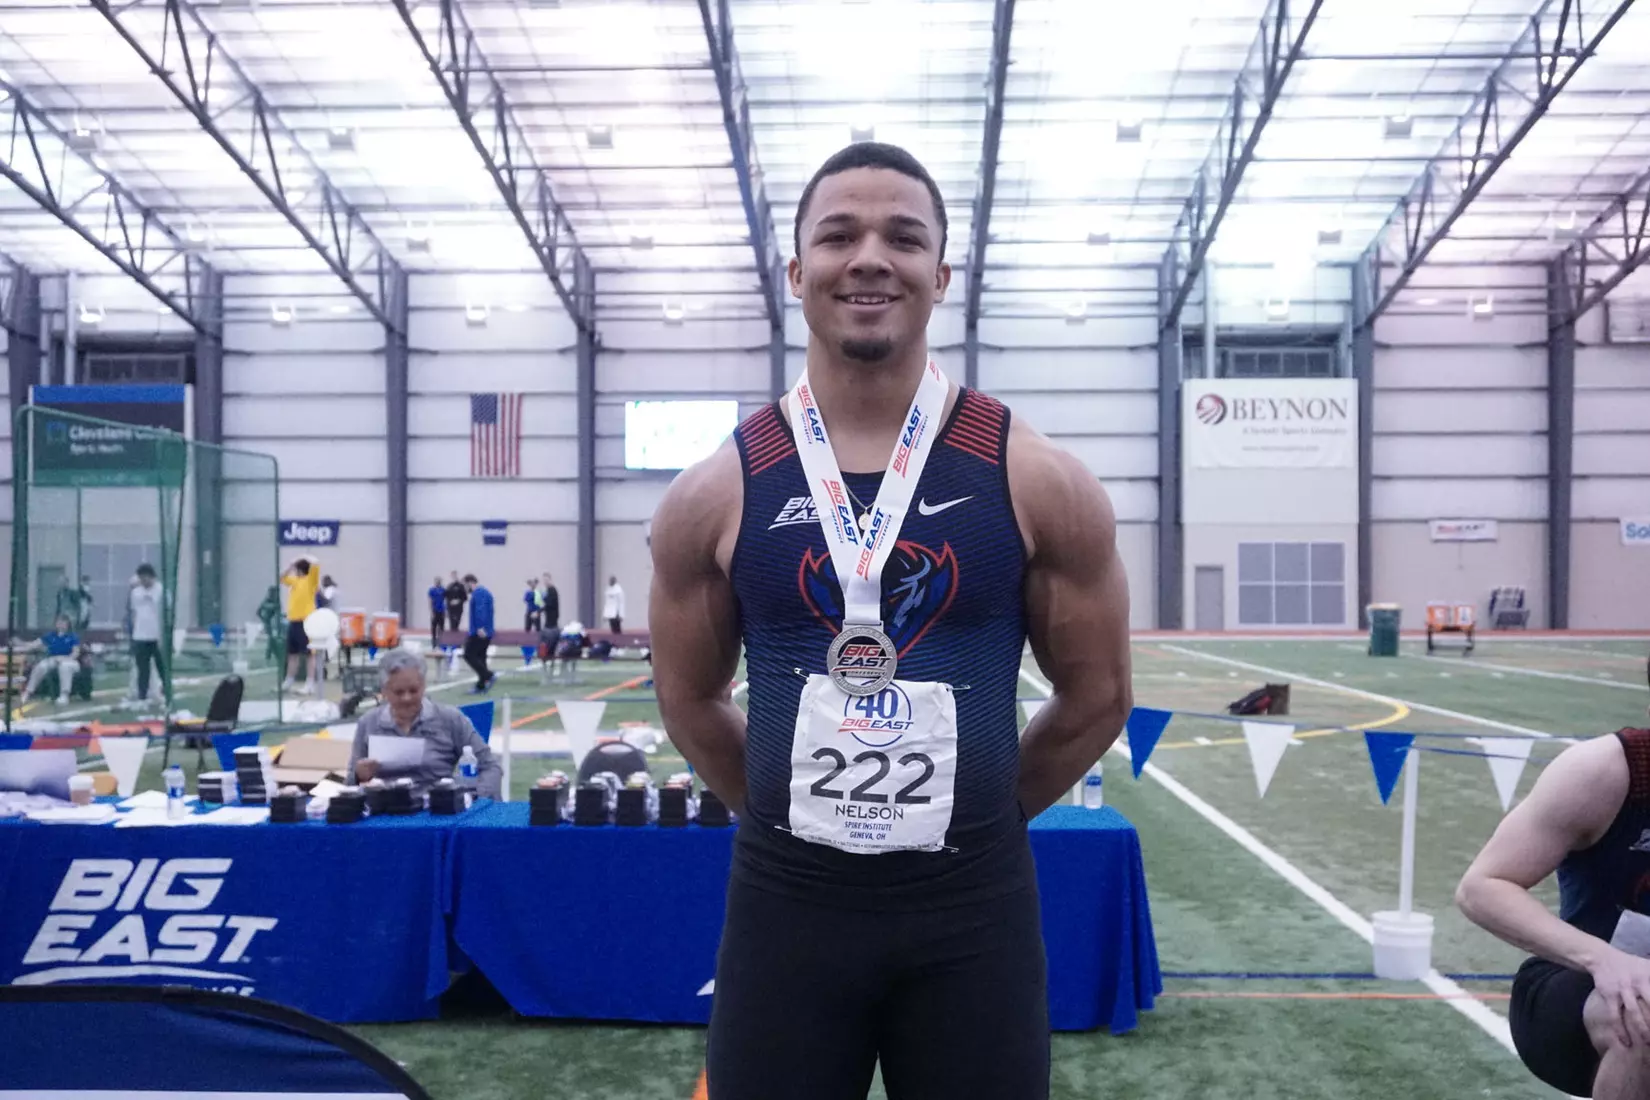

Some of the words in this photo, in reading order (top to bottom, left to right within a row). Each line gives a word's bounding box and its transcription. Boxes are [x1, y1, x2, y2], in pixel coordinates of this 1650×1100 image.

[1232, 398, 1348, 420] BEYNON
[807, 408, 826, 444] EAST
[893, 444, 907, 472] BIG
[902, 405, 921, 448] EAST
[830, 481, 846, 505] BIG
[838, 505, 859, 546] EAST
[283, 523, 332, 543] Jeep
[856, 548, 870, 576] BIG
[865, 507, 884, 551] EAST
[837, 657, 891, 668] EAST
[843, 645, 881, 656] BIG
[855, 688, 899, 719] 40
[842, 718, 871, 728] BIG
[870, 720, 914, 730] EAST
[810, 747, 934, 804] 222
[835, 804, 904, 820] NELSON
[845, 821, 861, 830] SPIRE
[862, 822, 892, 831] INSTITUTE
[49, 858, 233, 911] BIG
[22, 914, 279, 964] EAST
